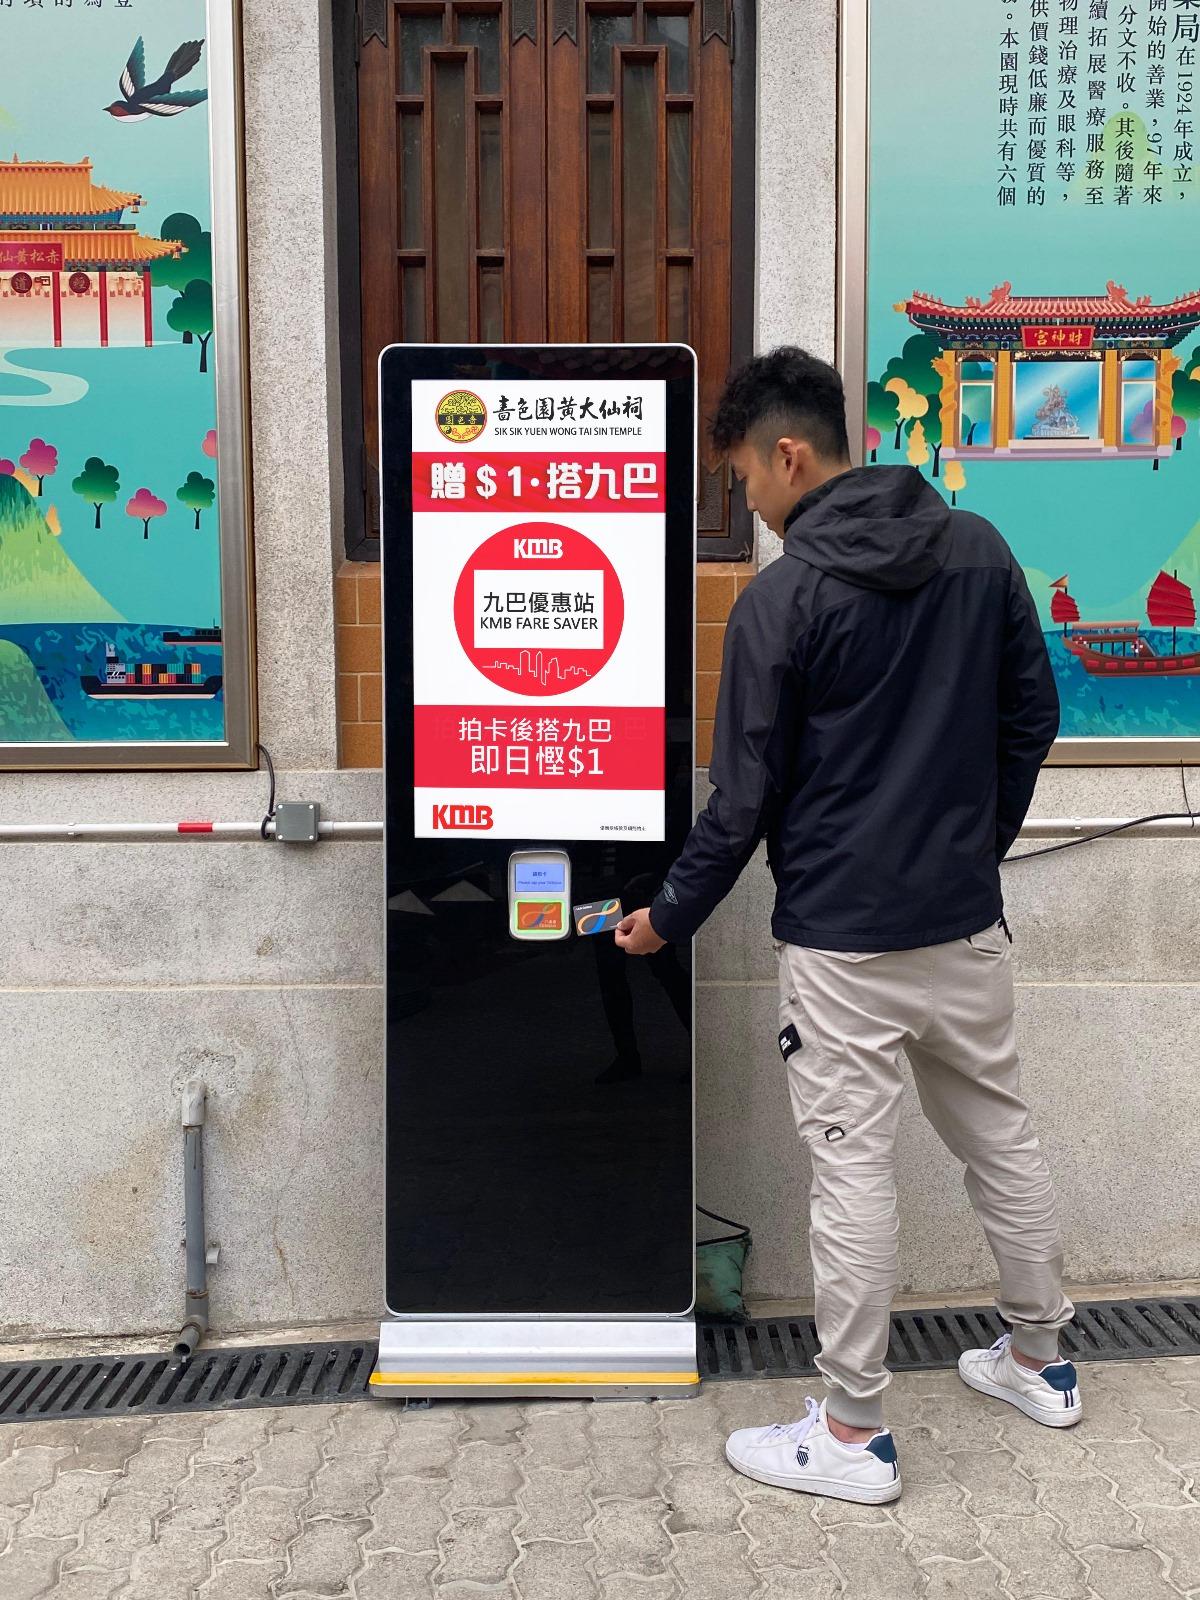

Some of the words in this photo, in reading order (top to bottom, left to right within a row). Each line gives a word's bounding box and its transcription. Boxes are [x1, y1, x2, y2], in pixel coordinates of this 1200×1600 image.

[997, 0, 1019, 207] 。本園現時共有六個
[494, 427, 508, 436] SIK
[509, 427, 523, 436] SIK
[524, 427, 548, 436] YUEN
[549, 427, 577, 436] WONG
[578, 427, 593, 436] TAI
[593, 427, 608, 436] SIN
[609, 427, 643, 436] TEMPLE
[513, 538, 564, 559] KMB
[483, 592, 595, 614] 九巴優惠站
[480, 616, 512, 630] KMB
[516, 616, 550, 630] FARE
[553, 617, 599, 630] SAVER
[458, 716, 613, 743] 拍卡後搭九巴
[471, 744, 604, 778] 即日慳$1
[432, 804, 494, 830] KMB
